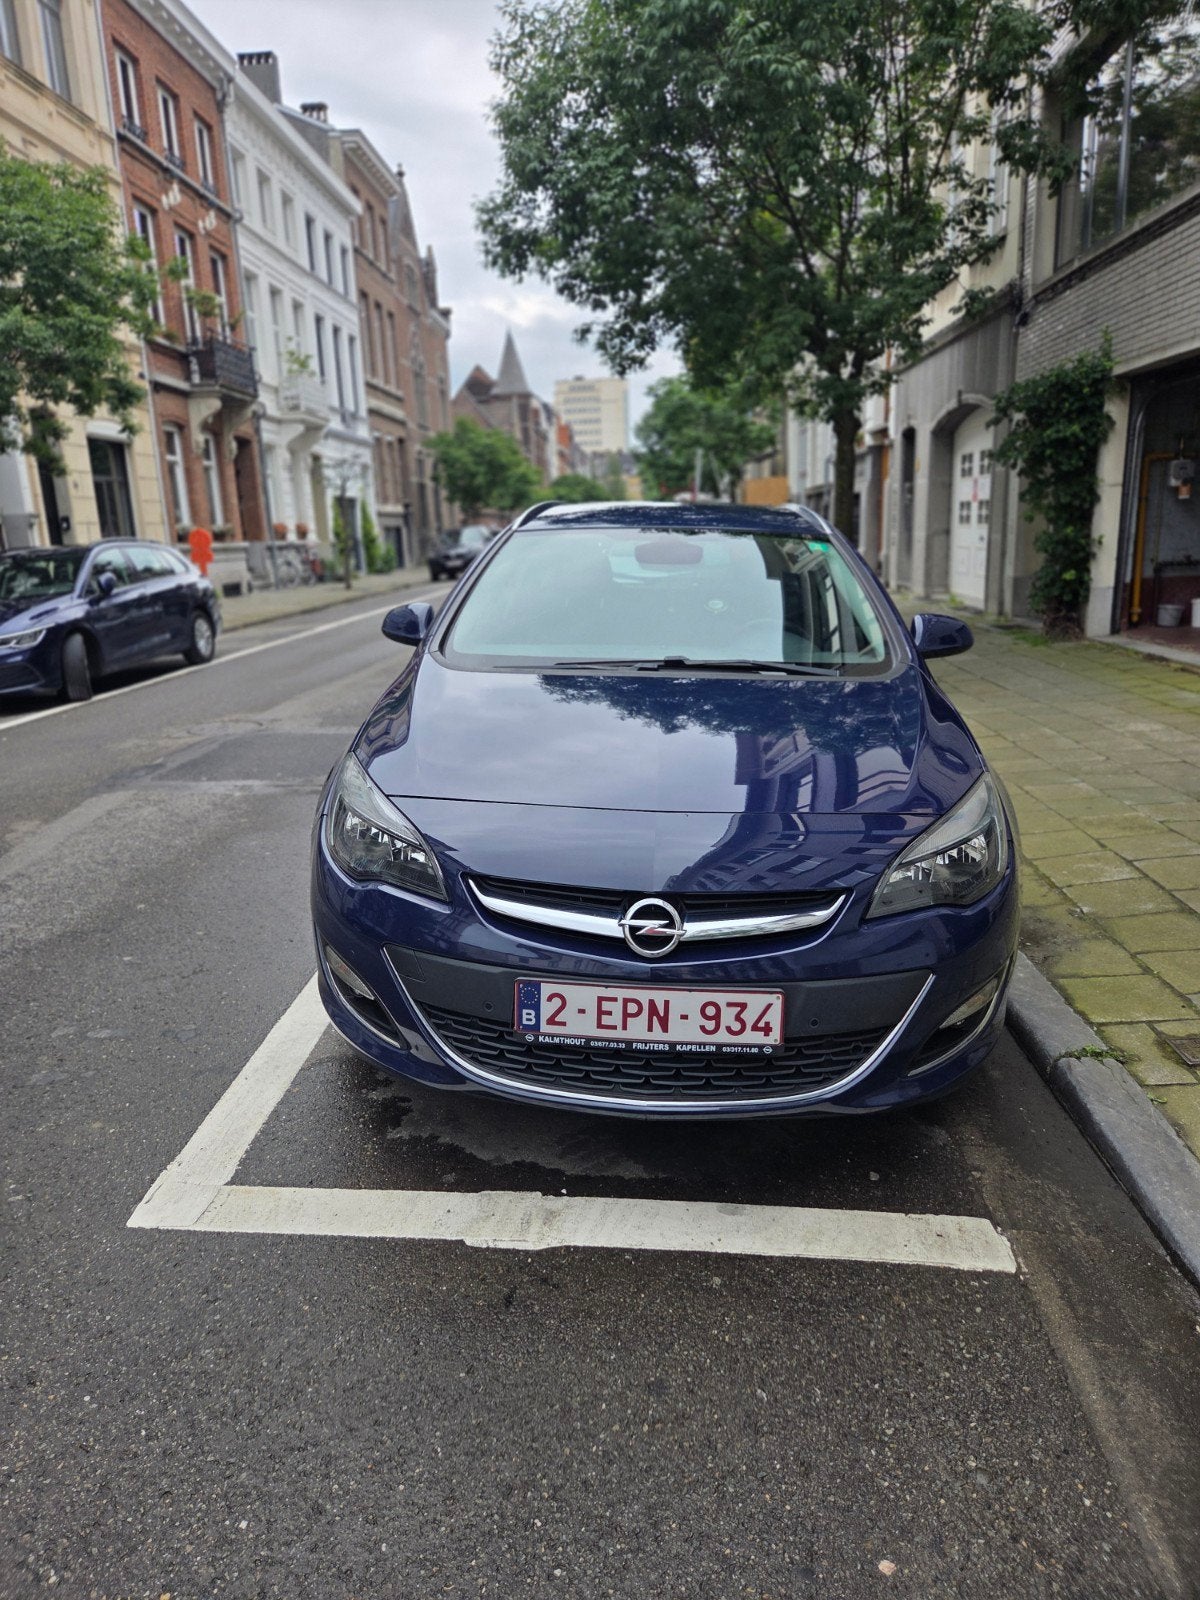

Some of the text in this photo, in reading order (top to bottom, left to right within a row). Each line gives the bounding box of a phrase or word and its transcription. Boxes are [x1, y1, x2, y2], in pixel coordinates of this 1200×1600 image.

[522, 1009, 536, 1025] B
[545, 992, 774, 1037] 2-EPN-934
[538, 1035, 586, 1045] KALMTHOUT
[632, 1043, 669, 1051] FRIJTERS
[676, 1044, 716, 1052] KAPELLEN
